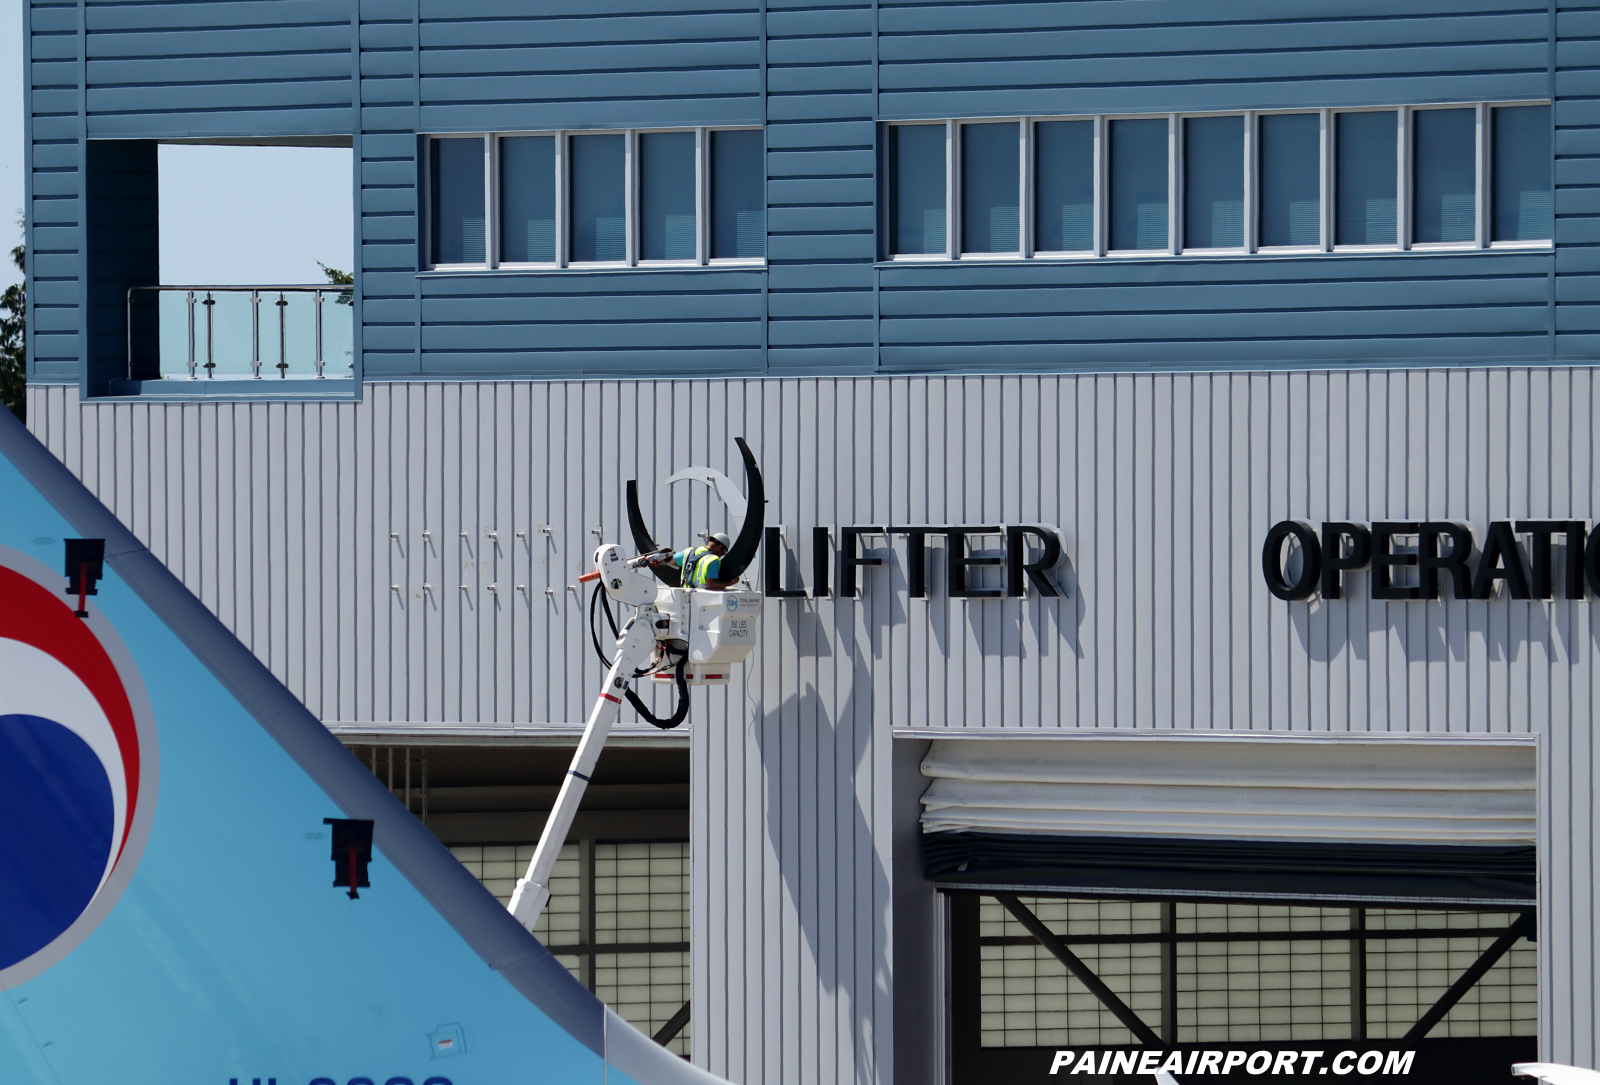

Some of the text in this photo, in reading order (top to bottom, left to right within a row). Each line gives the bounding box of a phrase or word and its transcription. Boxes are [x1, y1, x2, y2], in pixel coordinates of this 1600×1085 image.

[764, 519, 1600, 601] LIFTER OPERATI
[729, 630, 748, 638] CAPACITY
